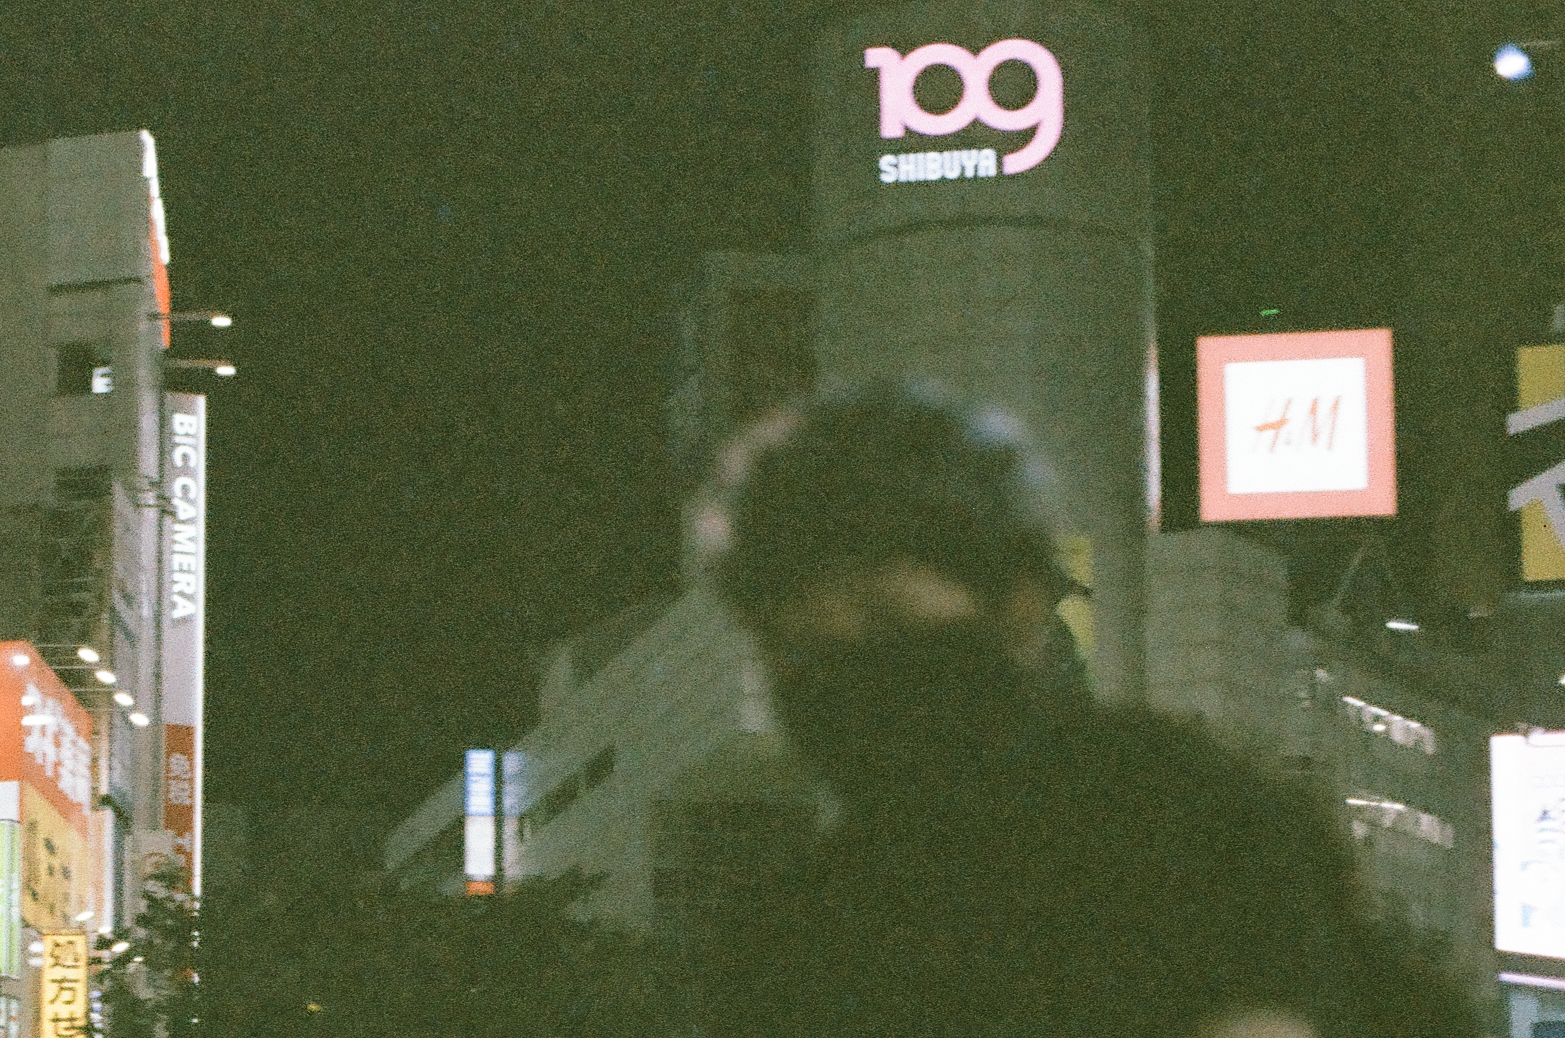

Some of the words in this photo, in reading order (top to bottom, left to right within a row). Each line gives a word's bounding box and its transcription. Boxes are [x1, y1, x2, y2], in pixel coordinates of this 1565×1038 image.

[865, 37, 1064, 175] 109
[879, 148, 998, 184] SHIBUYA
[172, 475, 197, 619] CAMERA
